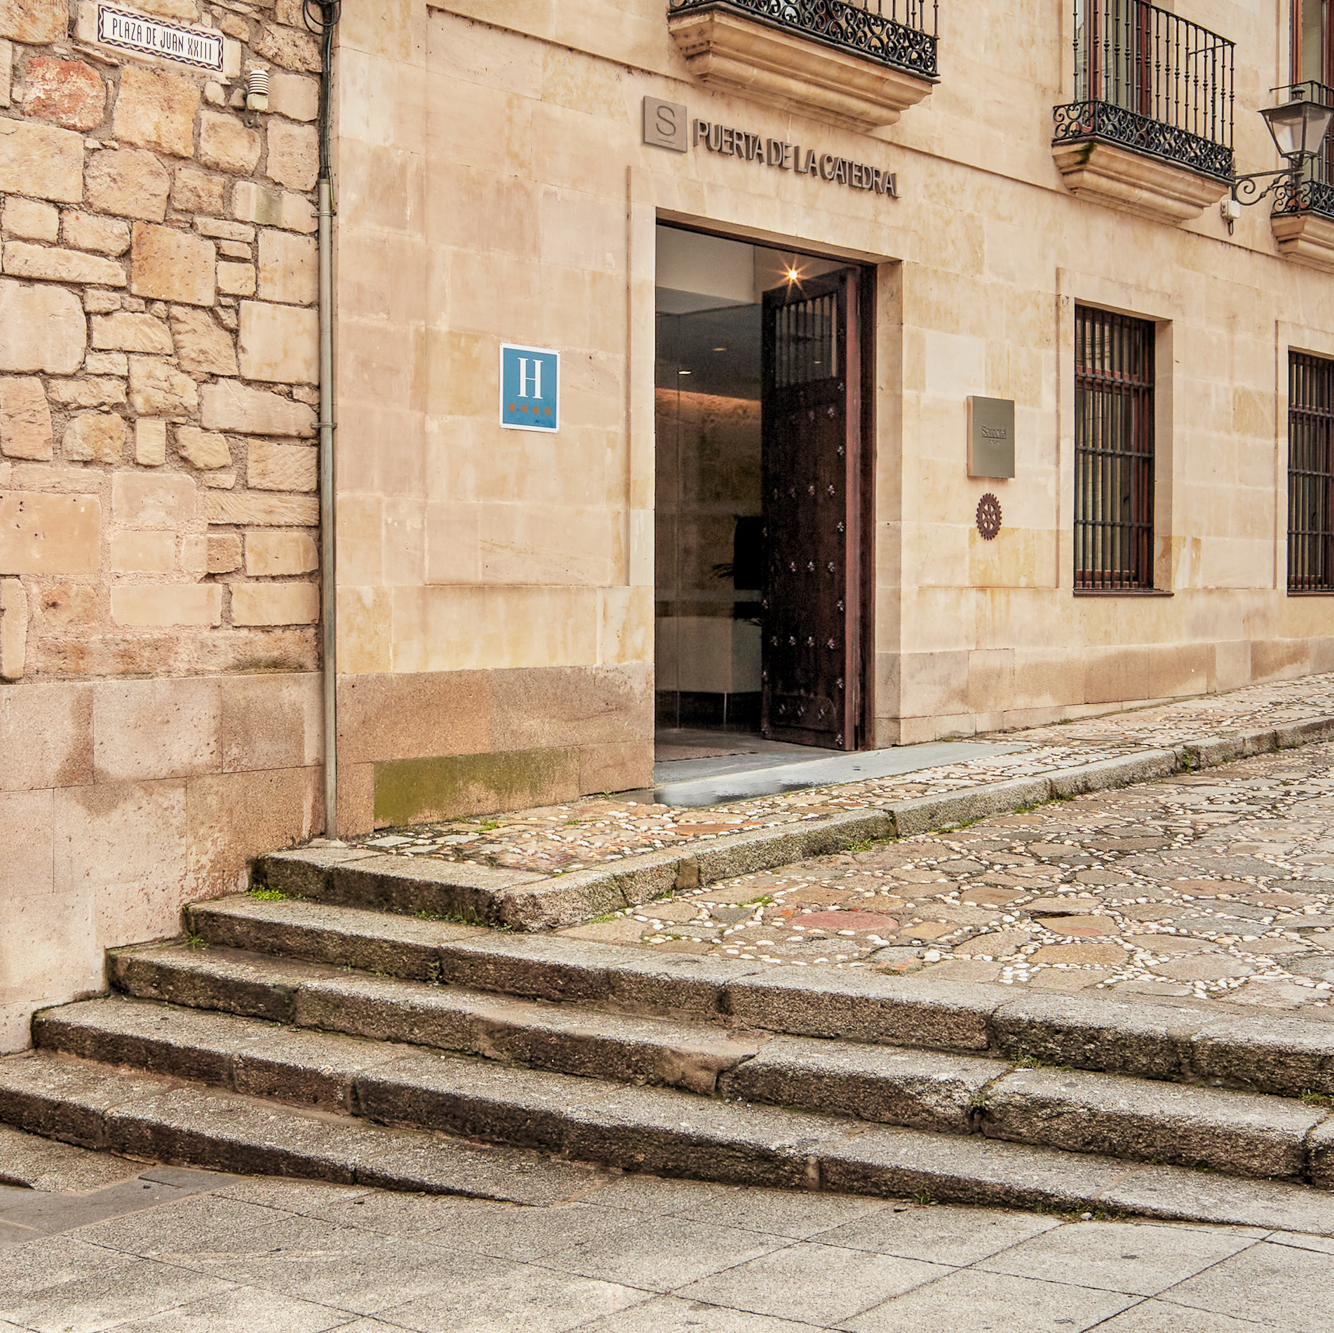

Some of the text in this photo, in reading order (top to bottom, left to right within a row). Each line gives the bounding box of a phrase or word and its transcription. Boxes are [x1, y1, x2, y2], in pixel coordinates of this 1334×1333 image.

[112, 17, 212, 61] PLAZA DE JUAN XXIII
[693, 118, 902, 199] PUERTA DE LA CATEDRAL
[517, 357, 544, 400] H
